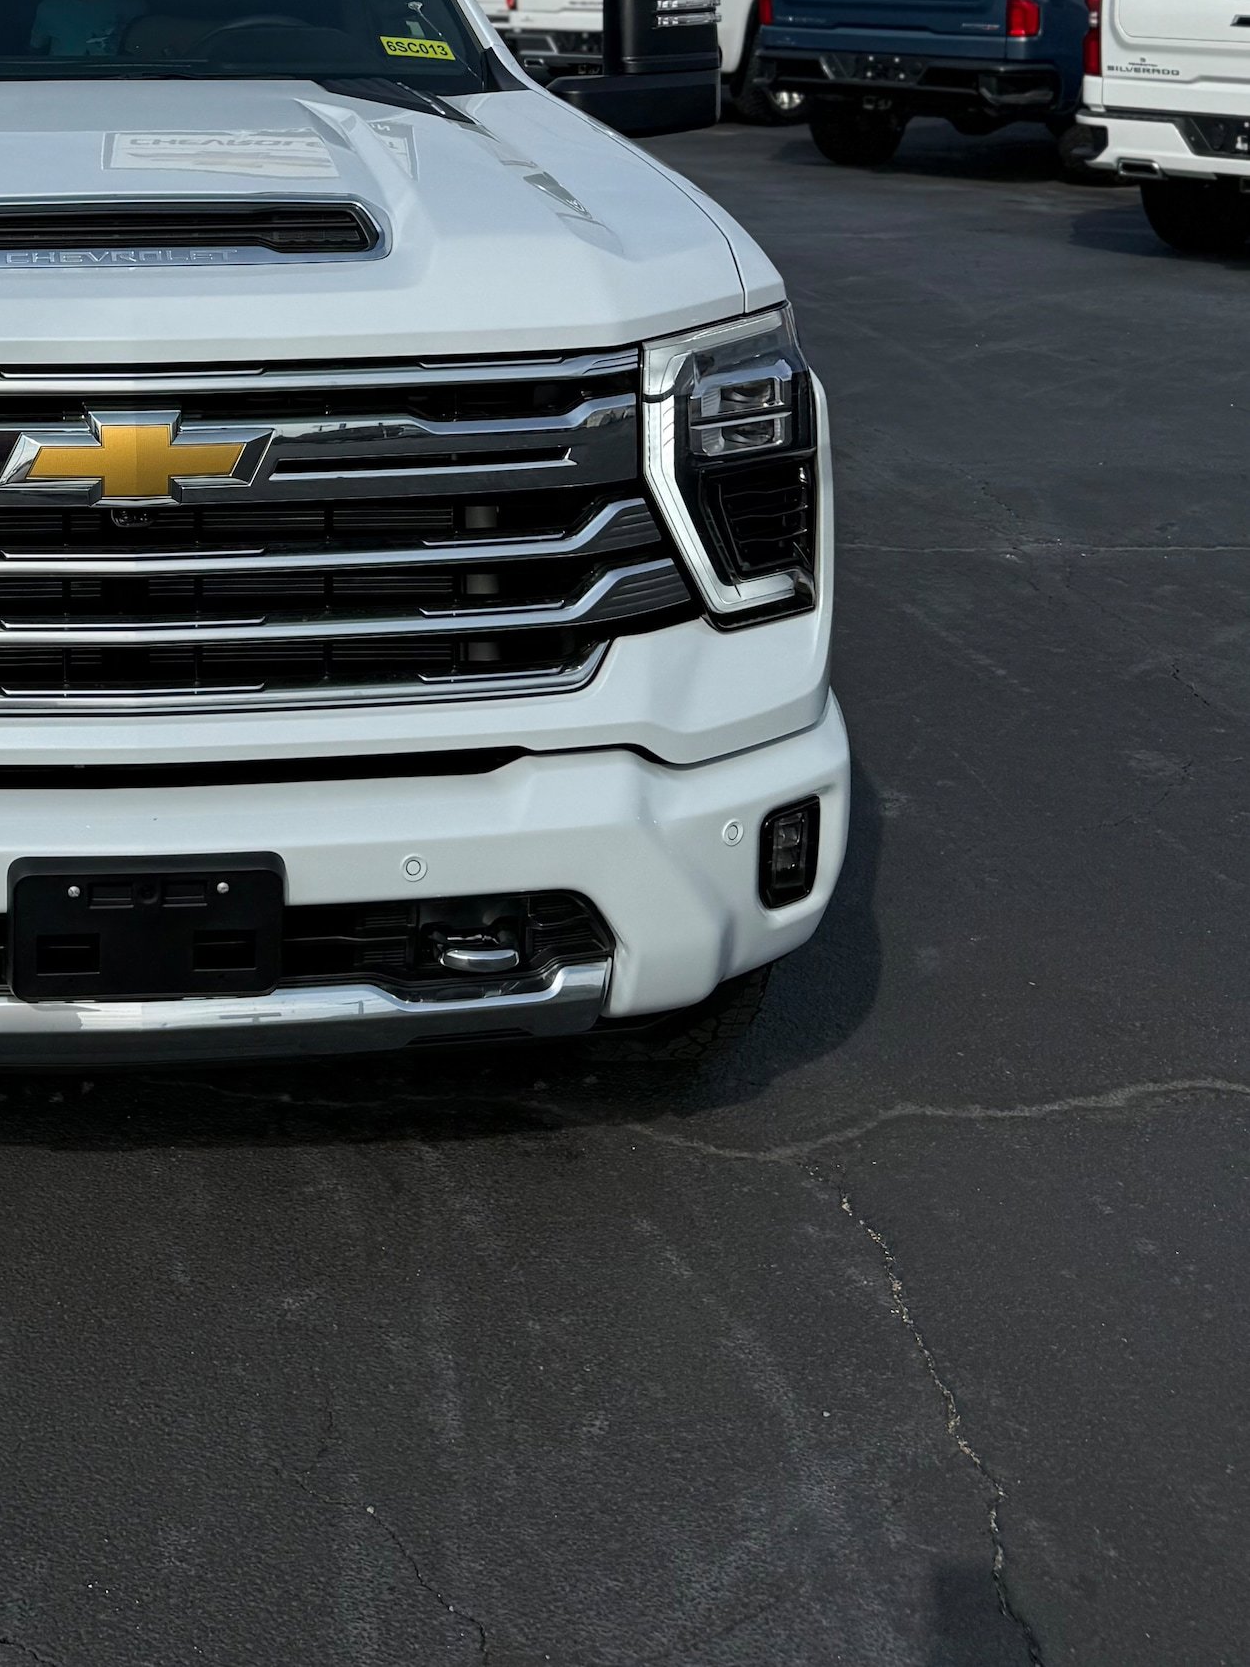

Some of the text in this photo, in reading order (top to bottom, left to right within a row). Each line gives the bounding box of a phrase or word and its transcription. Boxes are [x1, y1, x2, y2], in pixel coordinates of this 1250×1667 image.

[386, 40, 448, 56] 6SC013
[1107, 65, 1180, 76] SILVERADO
[6, 249, 238, 264] CHEVROLET
